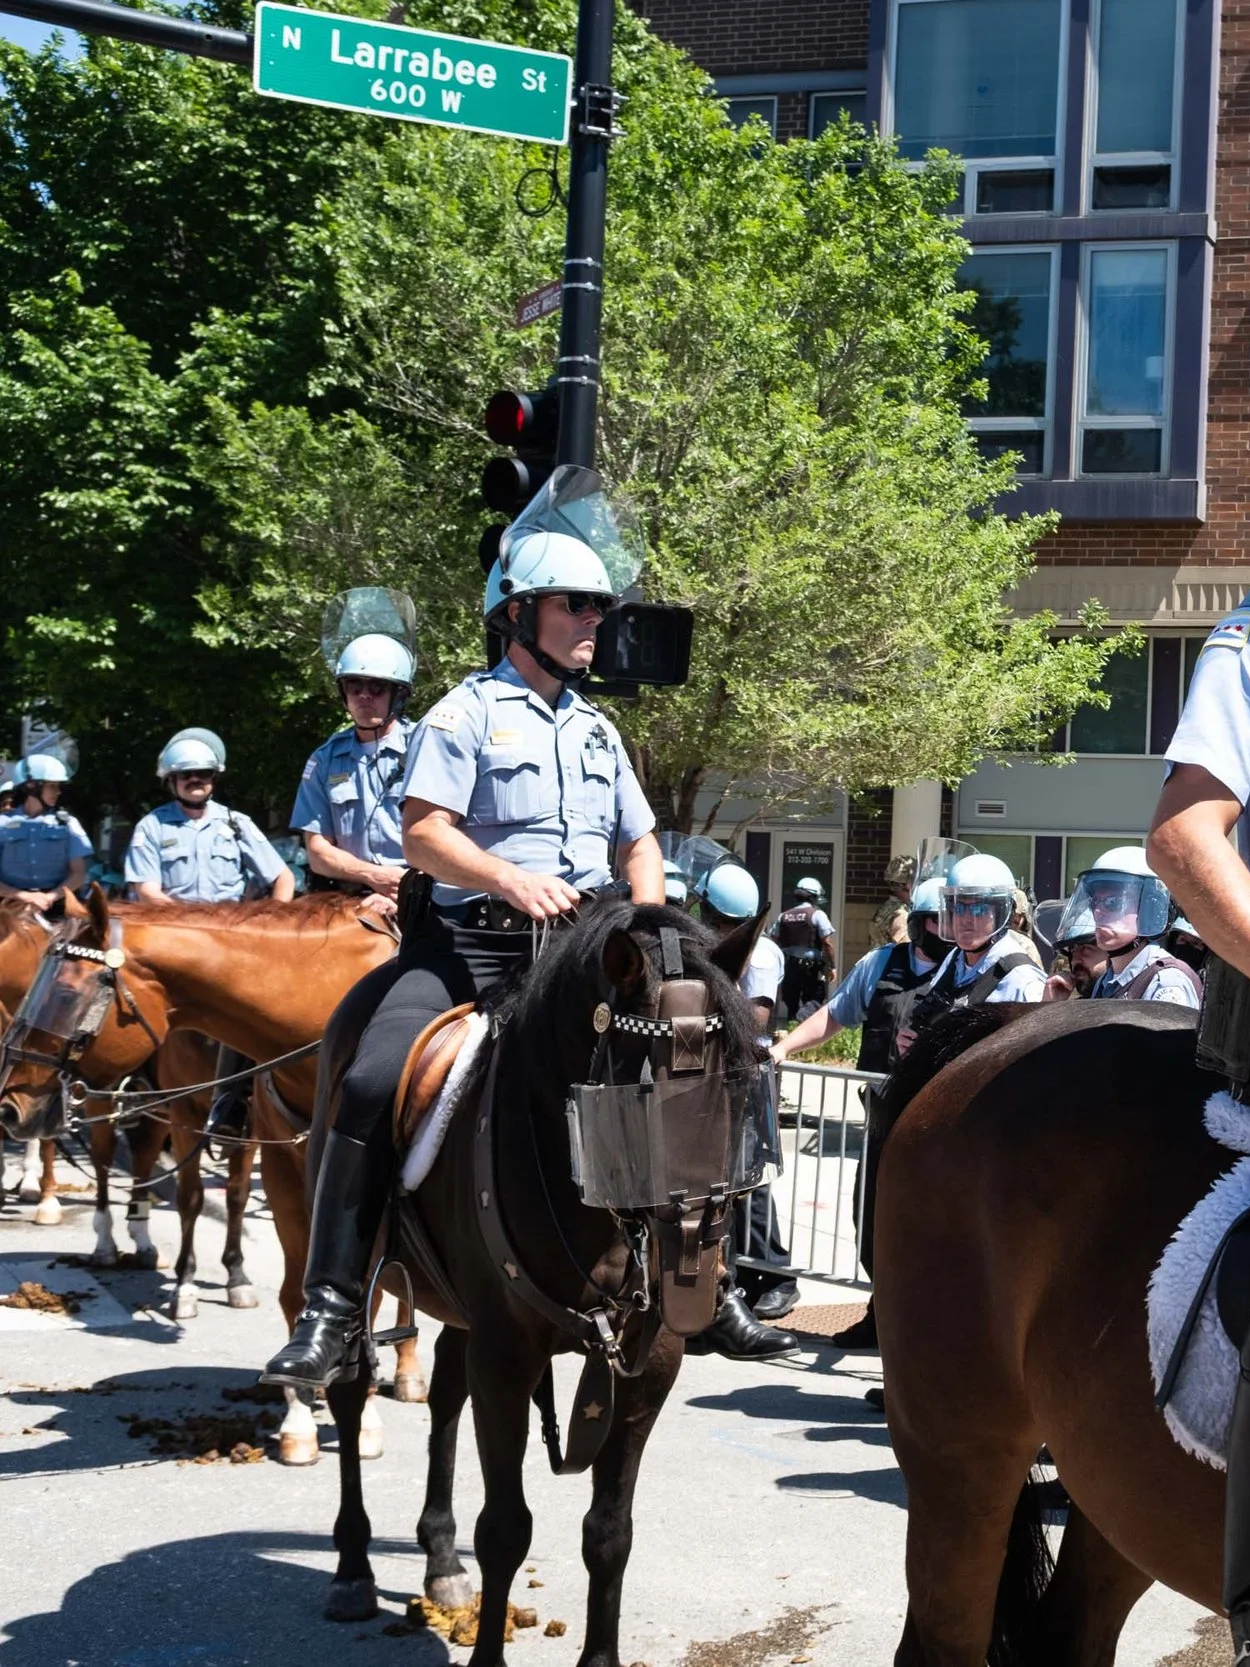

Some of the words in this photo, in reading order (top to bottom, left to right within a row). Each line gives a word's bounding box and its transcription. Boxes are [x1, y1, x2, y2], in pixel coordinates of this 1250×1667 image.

[282, 25, 301, 50] N
[330, 29, 497, 89] Larrabee
[521, 68, 547, 93] St
[370, 79, 426, 108] 600
[441, 89, 463, 113] W
[806, 848, 832, 856] Division
[784, 913, 806, 922] POLICE
